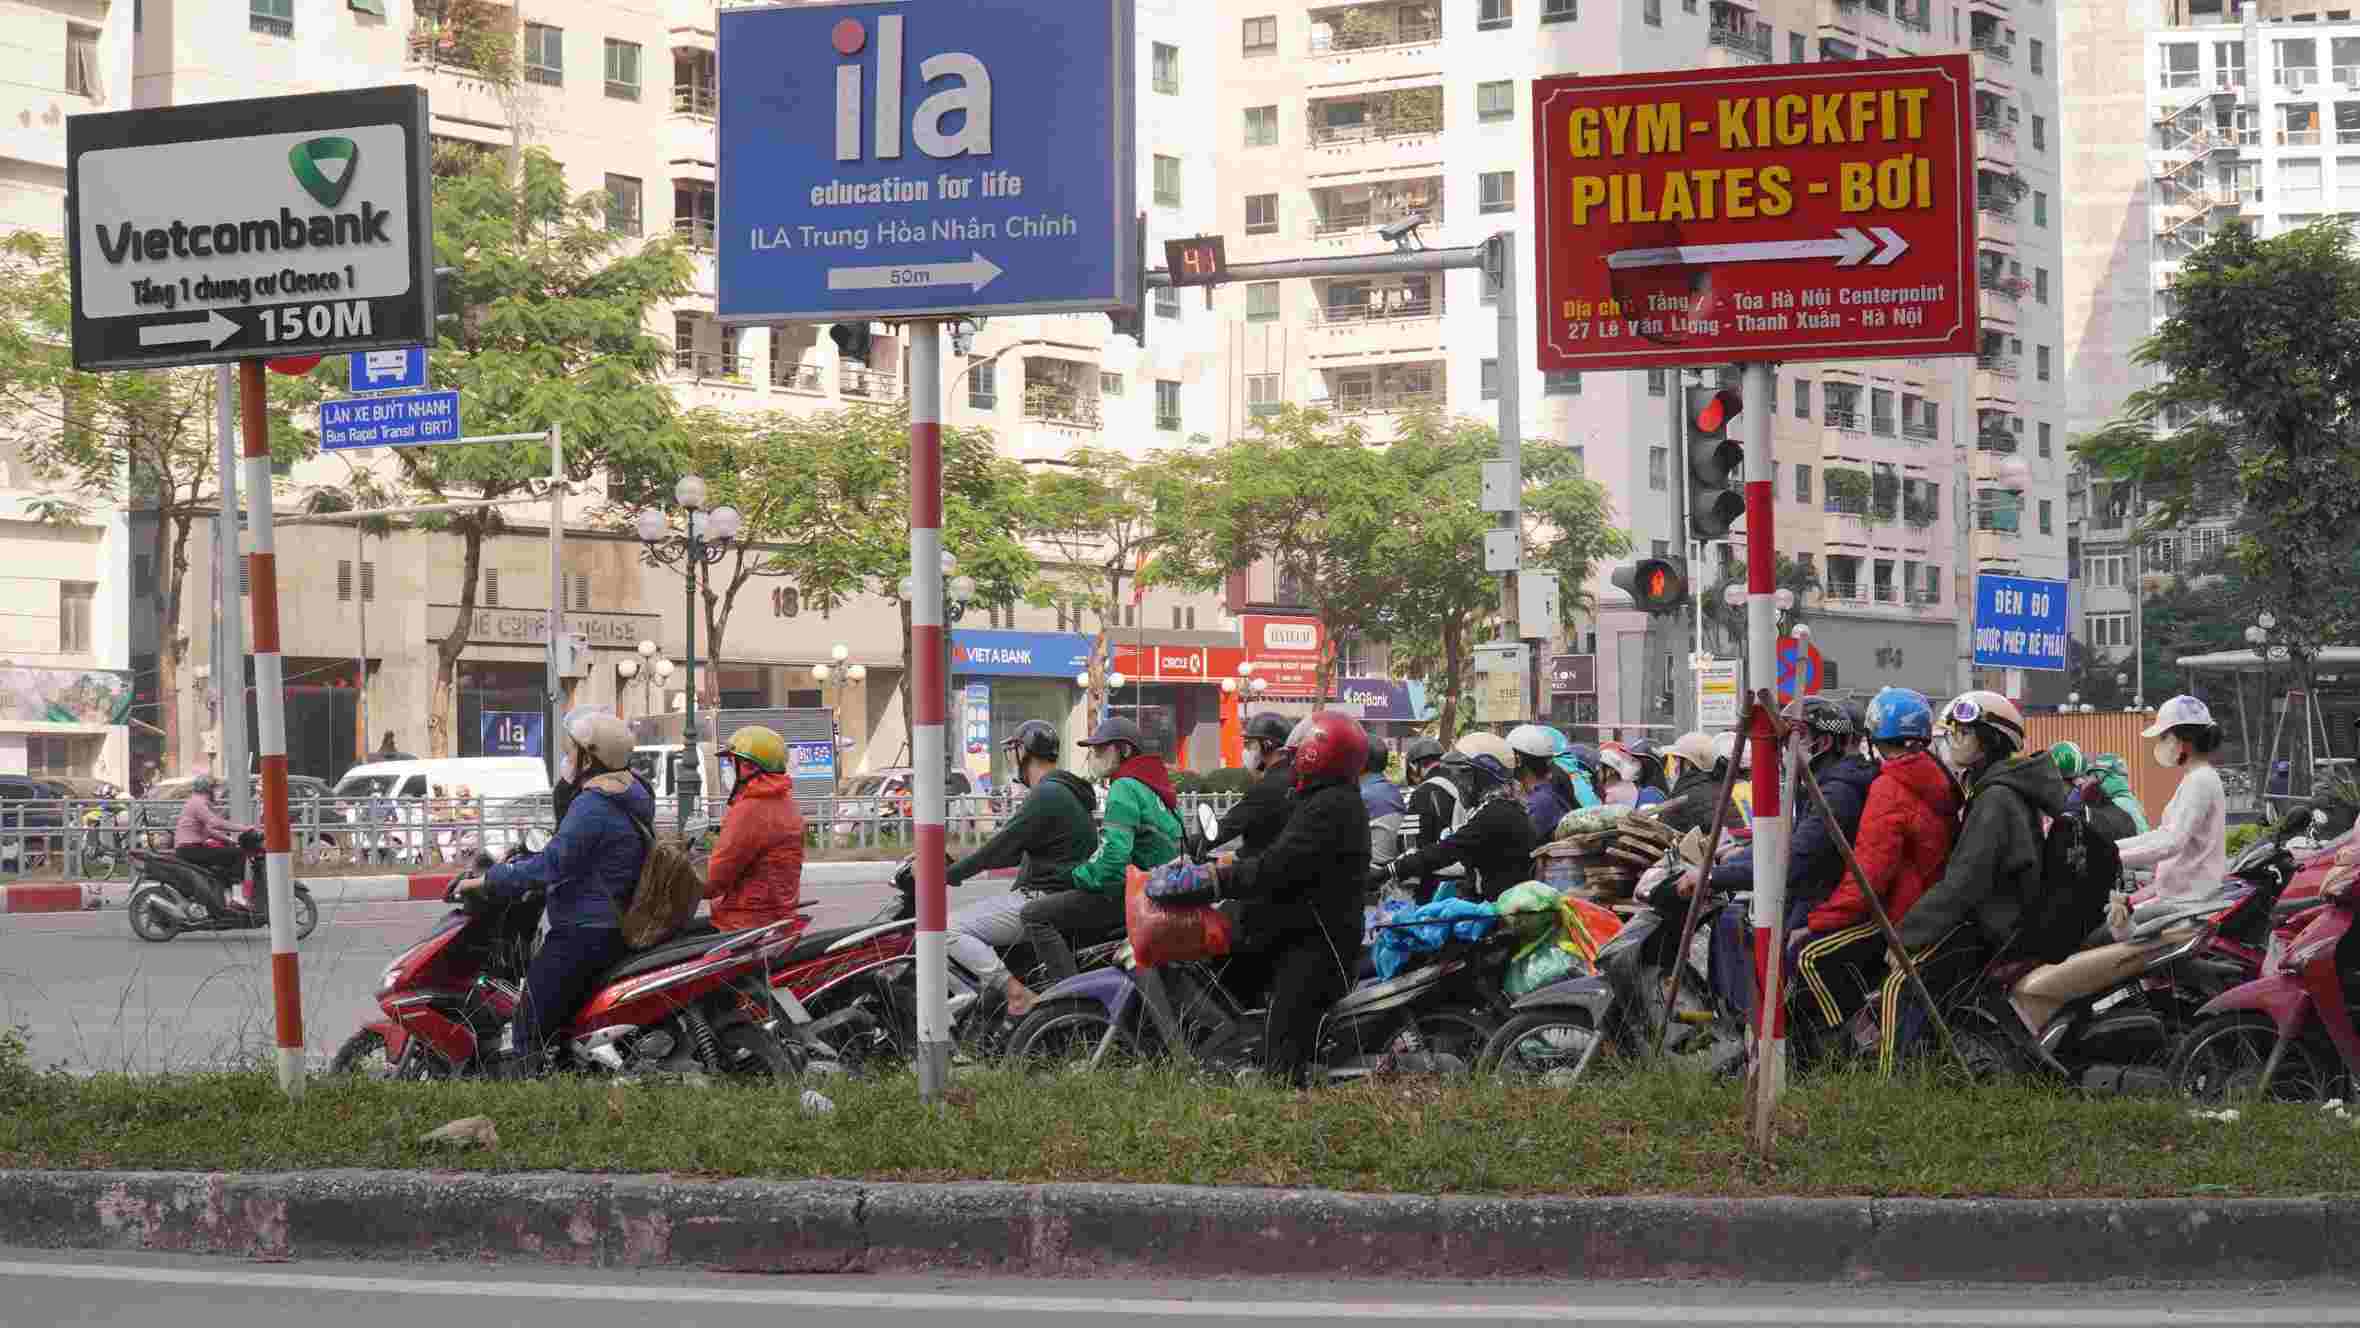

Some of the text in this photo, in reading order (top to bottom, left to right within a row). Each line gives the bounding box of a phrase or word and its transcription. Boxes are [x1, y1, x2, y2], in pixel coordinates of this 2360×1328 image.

[832, 15, 992, 160] ila
[1569, 102, 1683, 159] GYM
[1719, 89, 1930, 149] KICKFIT
[811, 170, 1022, 207] education for life
[1572, 166, 1794, 225] PILATES
[1840, 152, 1931, 212] BƠI
[95, 201, 391, 265] Vietcombank
[751, 214, 1076, 251] ILA Trung Hòa Nhân Chính
[890, 269, 930, 285] 50m
[1184, 247, 1216, 273] 41
[180, 277, 191, 302] 1
[194, 274, 250, 304] chung
[344, 265, 355, 289] 1
[1839, 284, 1945, 306] Centerpoint
[259, 300, 374, 342] 150M
[1568, 322, 1592, 339] 27
[1736, 313, 1788, 332] Thanh
[1796, 308, 1841, 329] Xuân
[1862, 308, 1886, 328] Hà
[1893, 307, 1923, 329] Nội
[354, 404, 371, 422] XE
[408, 399, 451, 417] NHANH
[326, 418, 453, 443] Bus Rapid Transit (BRT)
[1994, 584, 2023, 615] ĐÈN
